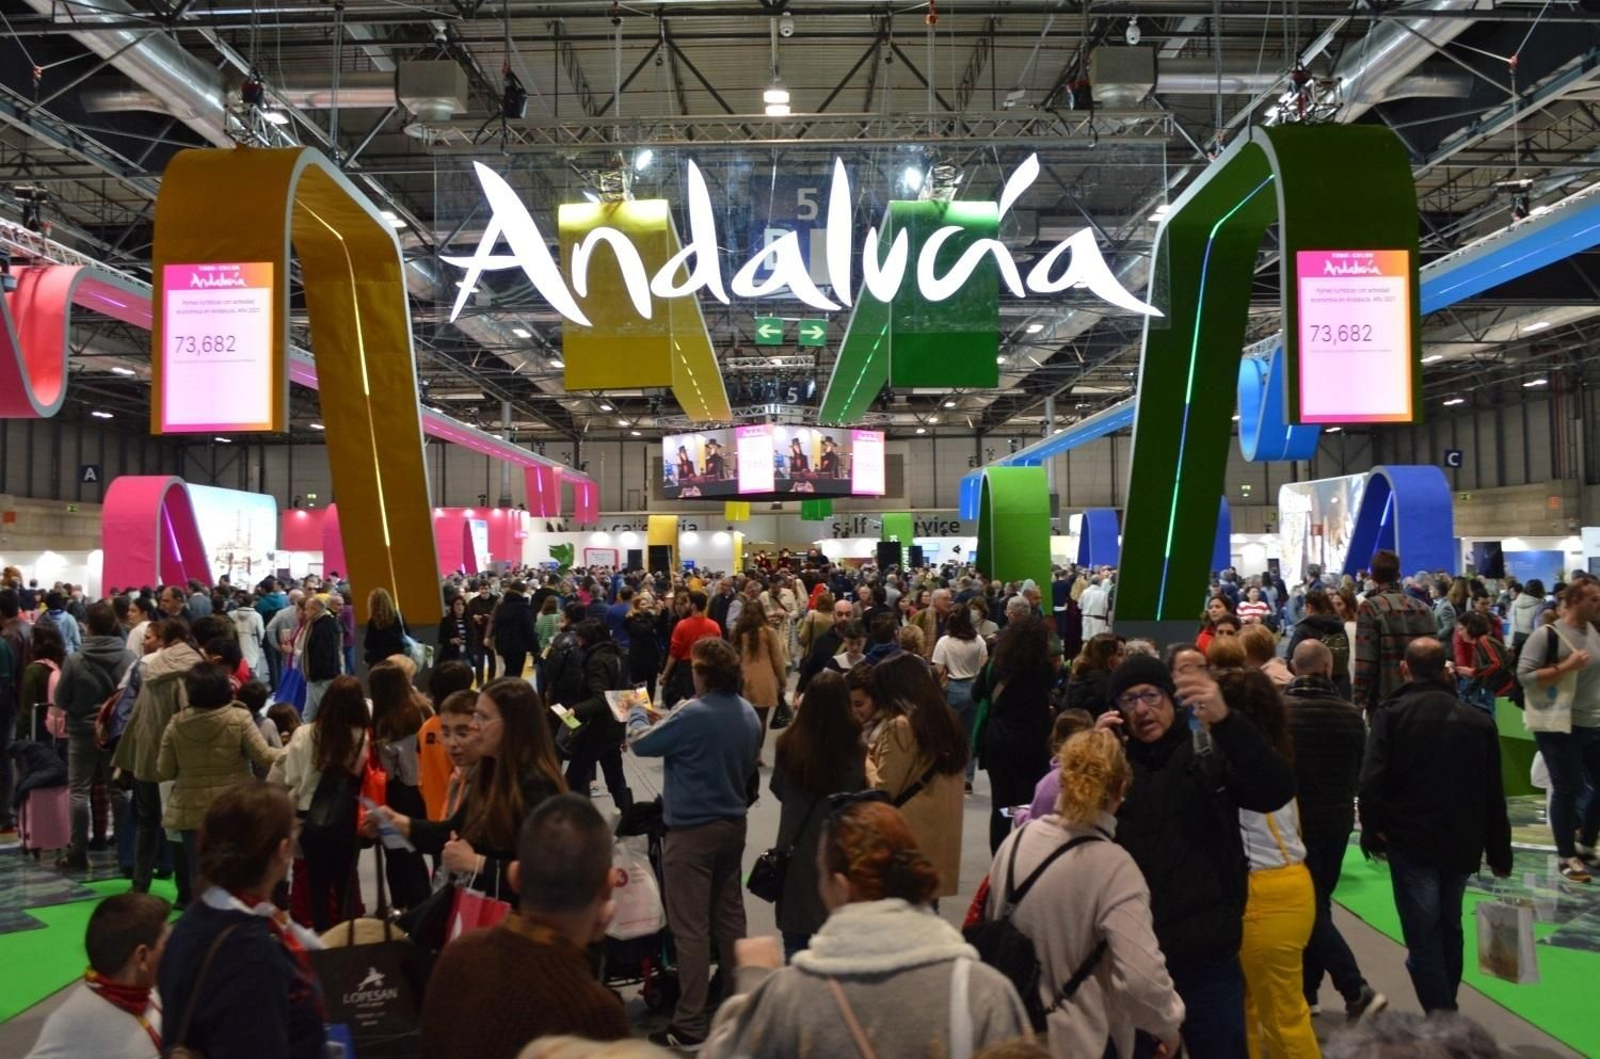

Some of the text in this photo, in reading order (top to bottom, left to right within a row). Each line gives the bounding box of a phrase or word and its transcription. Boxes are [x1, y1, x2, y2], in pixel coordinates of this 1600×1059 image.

[797, 188, 819, 221] 5
[438, 152, 1165, 327] Andalucía
[175, 335, 236, 357] 73,682
[1310, 324, 1373, 346] 73,682
[786, 387, 799, 404] 5
[1448, 453, 1460, 466] C
[84, 467, 97, 481] A
